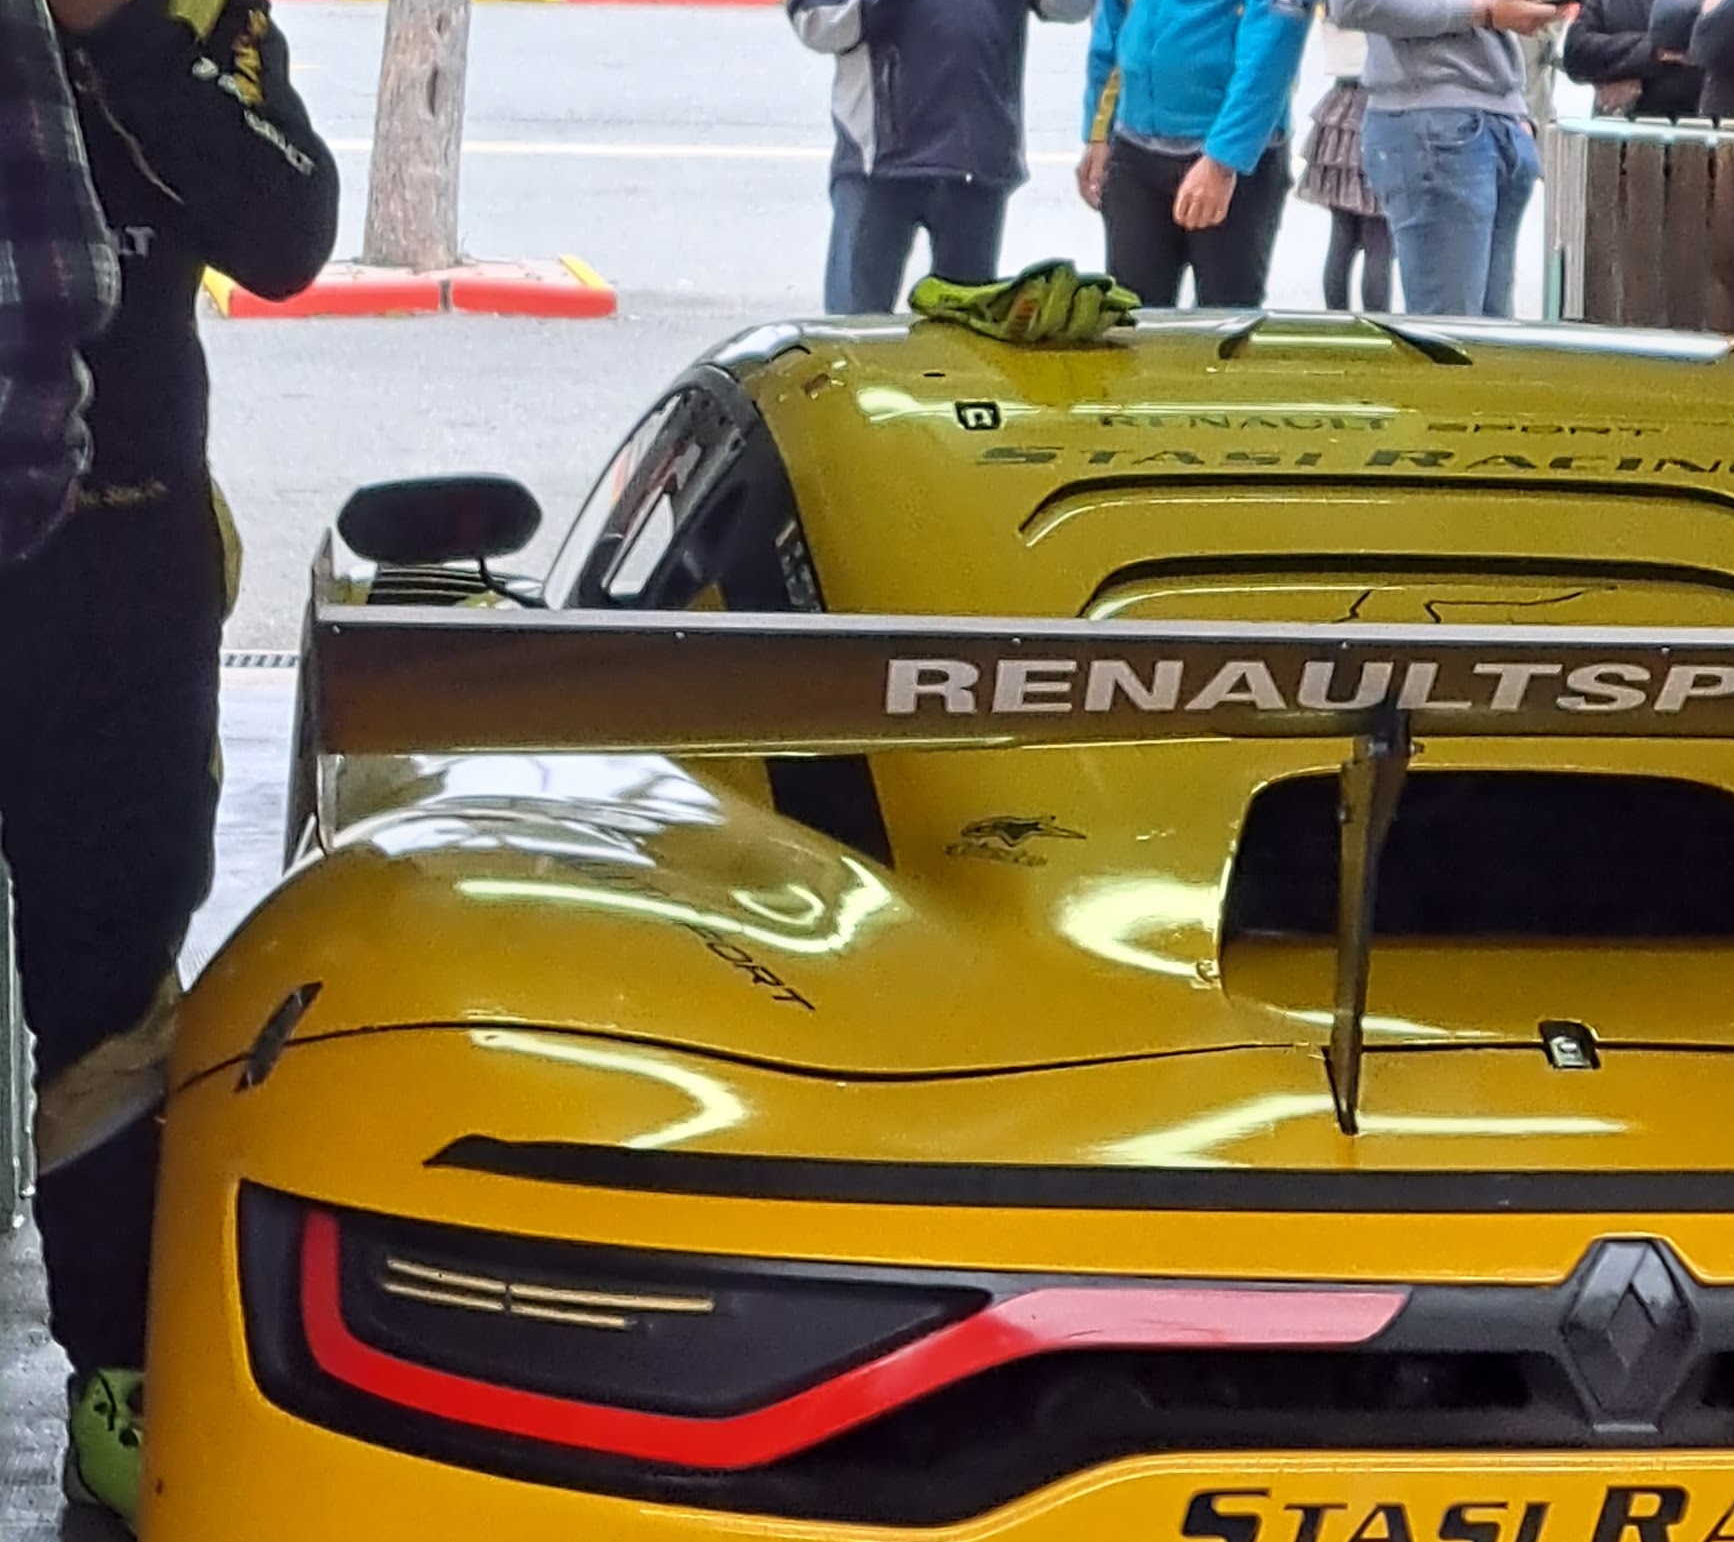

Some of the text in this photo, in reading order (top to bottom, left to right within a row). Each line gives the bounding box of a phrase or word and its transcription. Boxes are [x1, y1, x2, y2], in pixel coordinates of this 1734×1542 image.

[1099, 413, 1662, 436] RENAULT SPORT
[976, 446, 1322, 466] STASI
